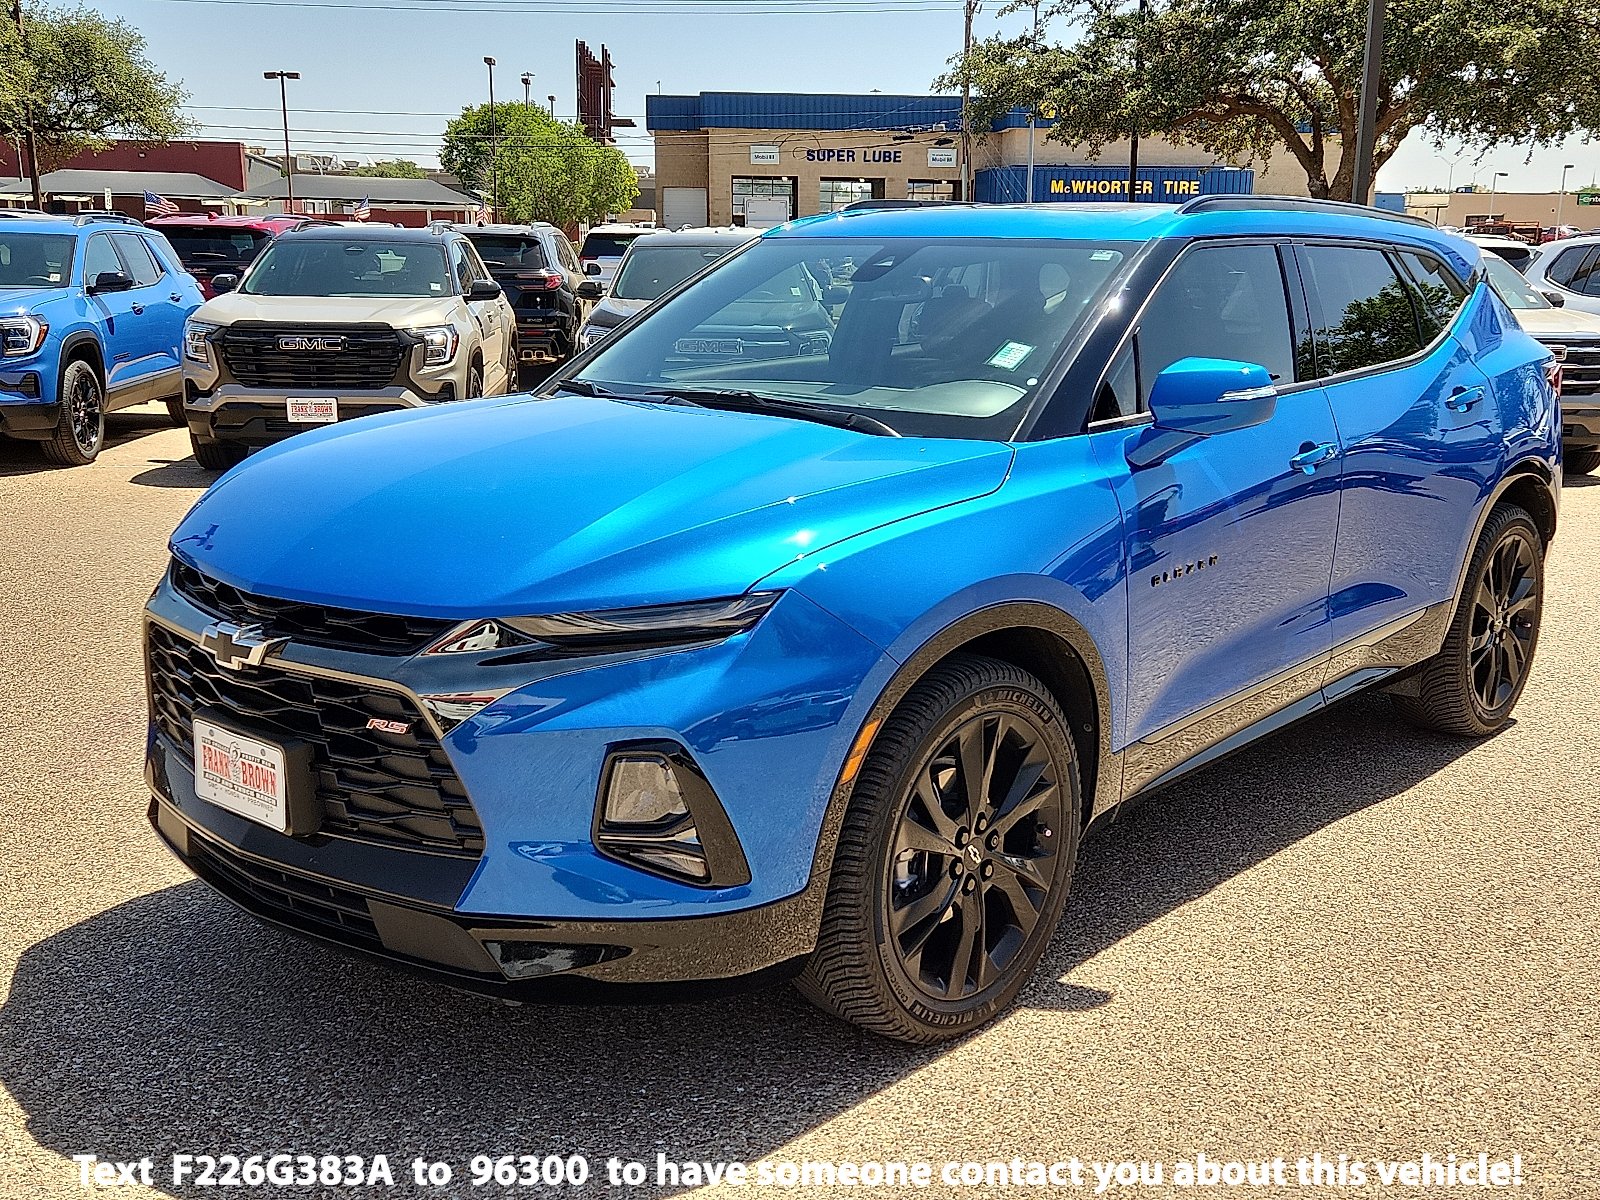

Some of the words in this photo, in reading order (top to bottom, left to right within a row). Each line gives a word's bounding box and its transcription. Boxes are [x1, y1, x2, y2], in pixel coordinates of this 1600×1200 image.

[806, 149, 856, 162] SUPER
[863, 150, 902, 163] LUBE
[1050, 179, 1153, 195] McWHORTER
[1163, 180, 1201, 195] TIRE
[279, 337, 342, 351] GMC
[679, 340, 739, 353] GMC
[1150, 554, 1219, 588] BLAZER
[996, 690, 1052, 721] MICHELIN
[366, 718, 409, 734] RS
[202, 744, 231, 780] FRANK
[241, 761, 277, 797] BROWN
[913, 1003, 974, 1026] MICHELIN
